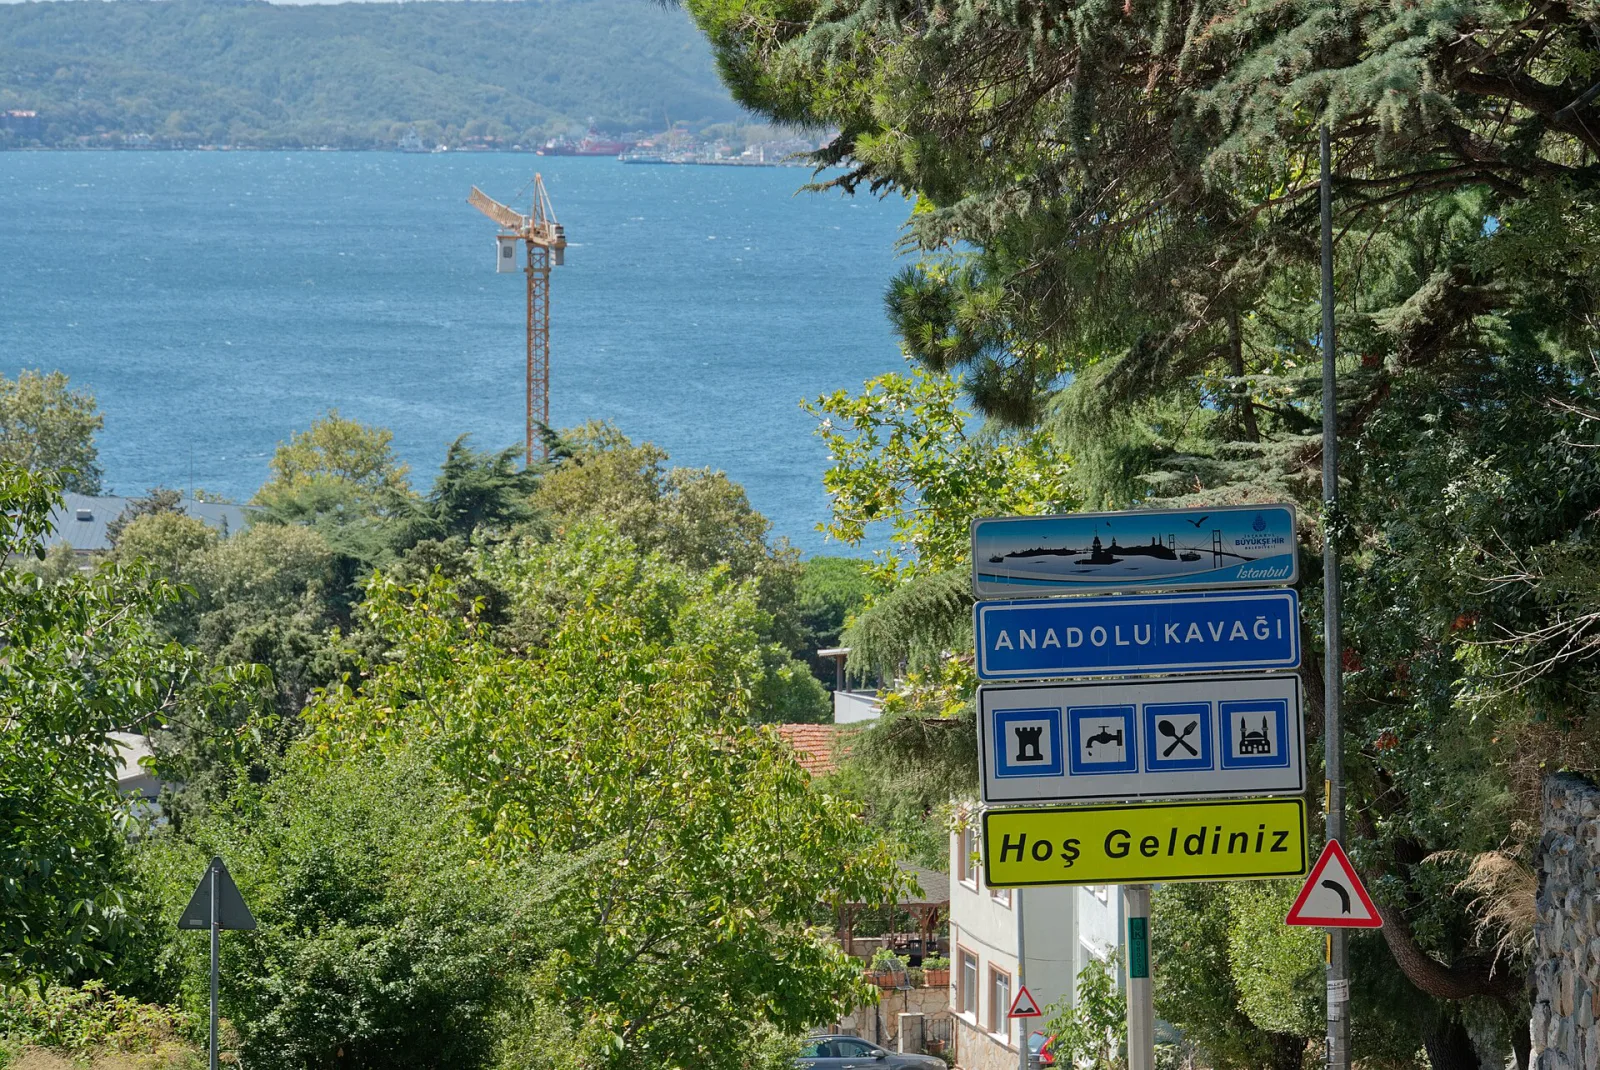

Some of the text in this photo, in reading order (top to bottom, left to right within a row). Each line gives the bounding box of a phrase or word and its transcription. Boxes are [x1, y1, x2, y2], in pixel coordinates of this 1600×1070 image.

[1235, 536, 1285, 546] BÜYÜKŞEHİR
[1236, 565, 1289, 579] İstanbul
[994, 615, 1282, 650] ANADOLU KAVAĞI
[1000, 824, 1290, 868] Hoş Geldiniz
